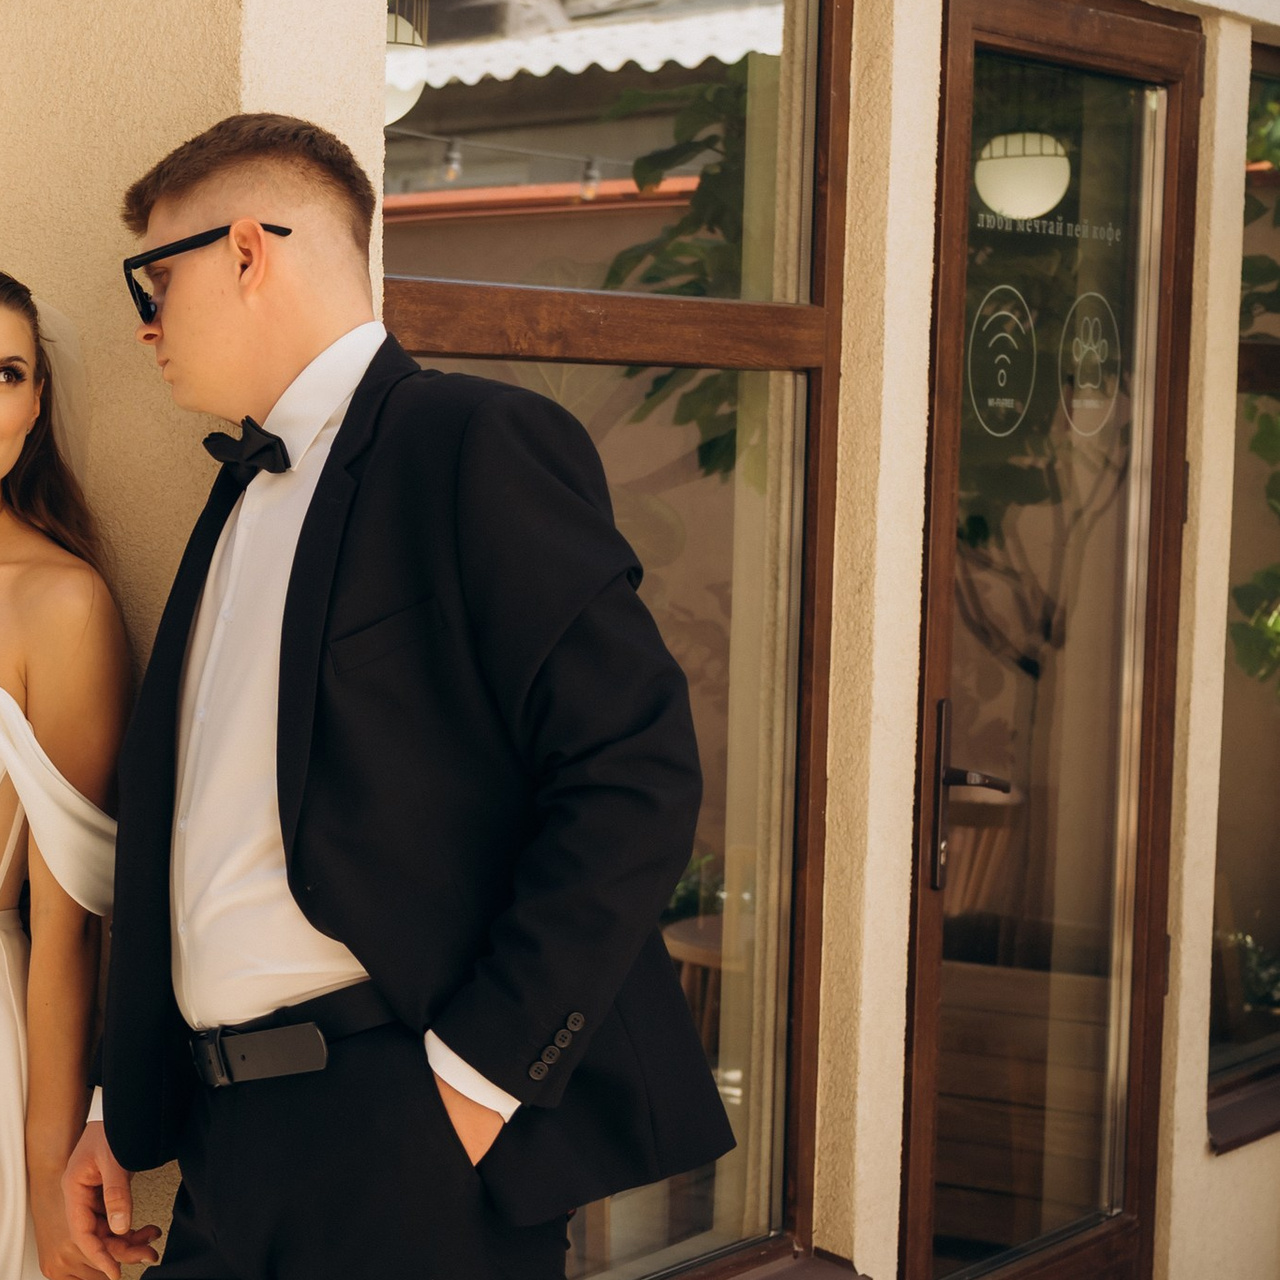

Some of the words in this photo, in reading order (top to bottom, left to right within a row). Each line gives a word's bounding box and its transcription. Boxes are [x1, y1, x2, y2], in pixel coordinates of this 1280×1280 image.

[1015, 214, 1063, 236] мечтай
[1066, 219, 1089, 239] пей
[1091, 222, 1122, 246] кофе
